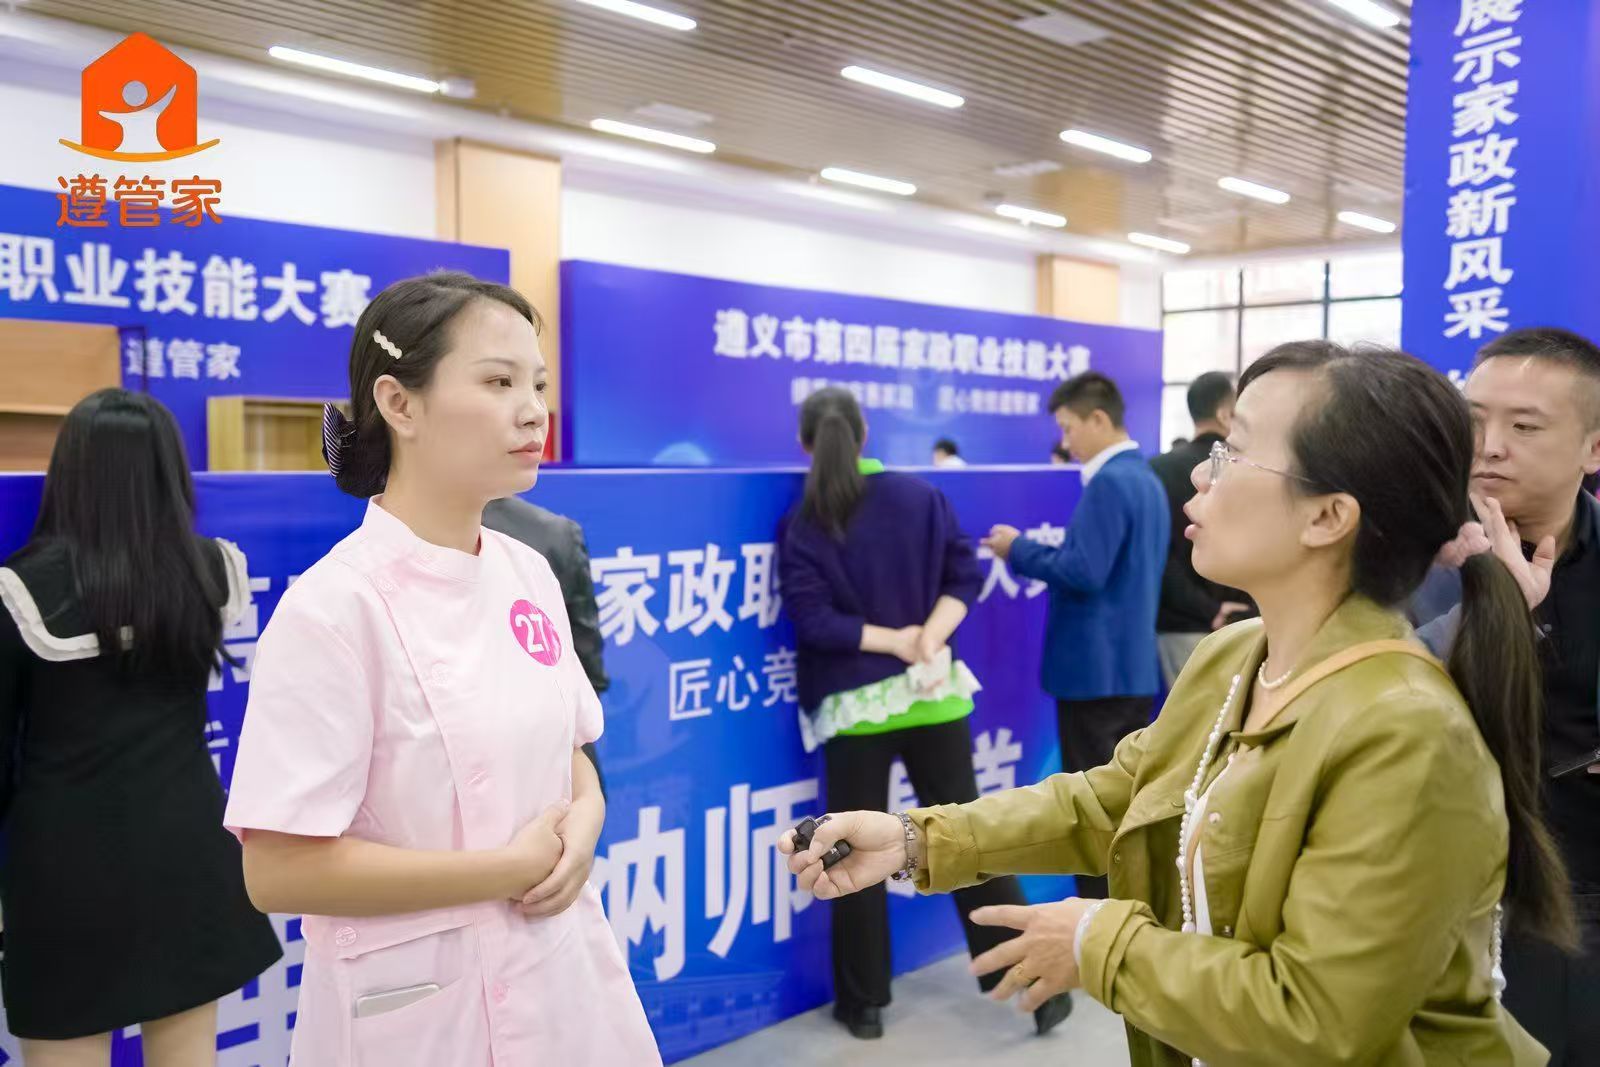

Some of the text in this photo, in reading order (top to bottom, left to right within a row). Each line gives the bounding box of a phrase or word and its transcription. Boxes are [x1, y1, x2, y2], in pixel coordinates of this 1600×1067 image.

[0, 233, 373, 329] 职业技能大赛
